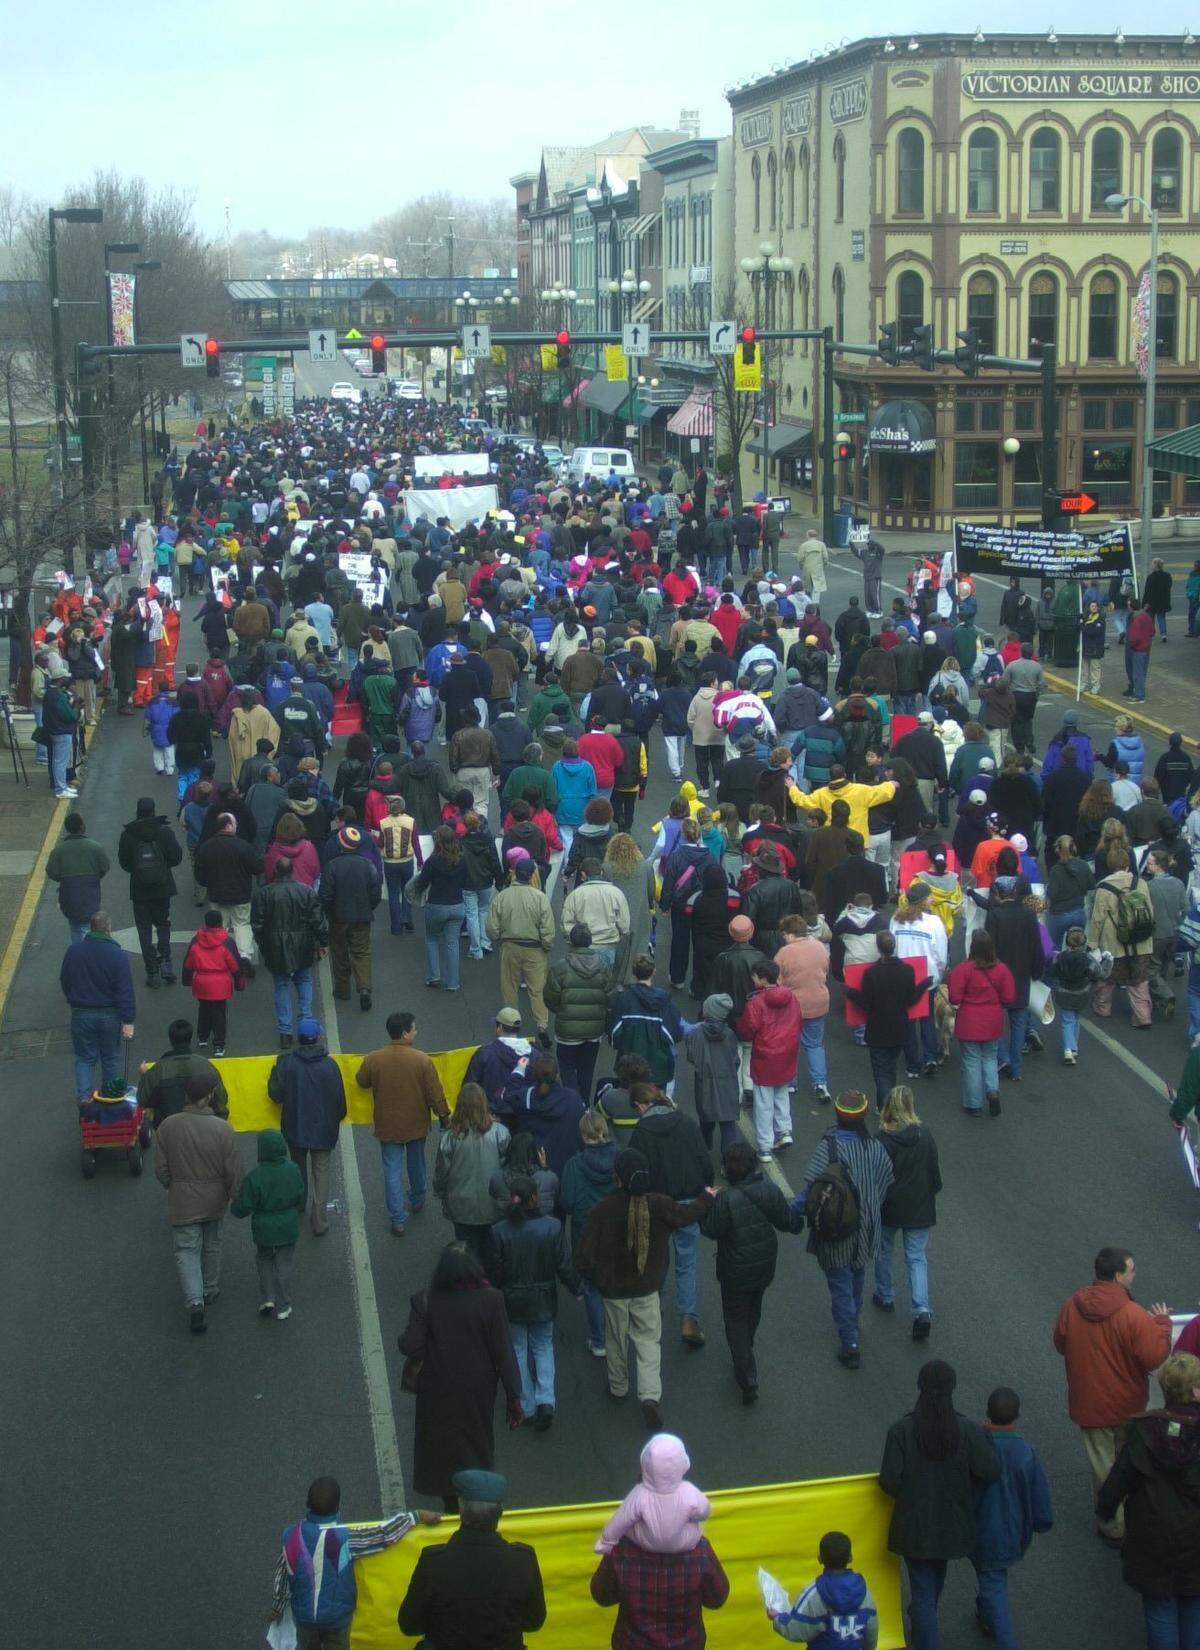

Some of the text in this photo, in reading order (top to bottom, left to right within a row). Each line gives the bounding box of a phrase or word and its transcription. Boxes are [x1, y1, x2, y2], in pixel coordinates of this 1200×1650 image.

[967, 75, 1200, 95] VICTORIAN SQUARE SHO
[870, 427, 909, 441] deSha's
[832, 1615, 865, 1641] UK
